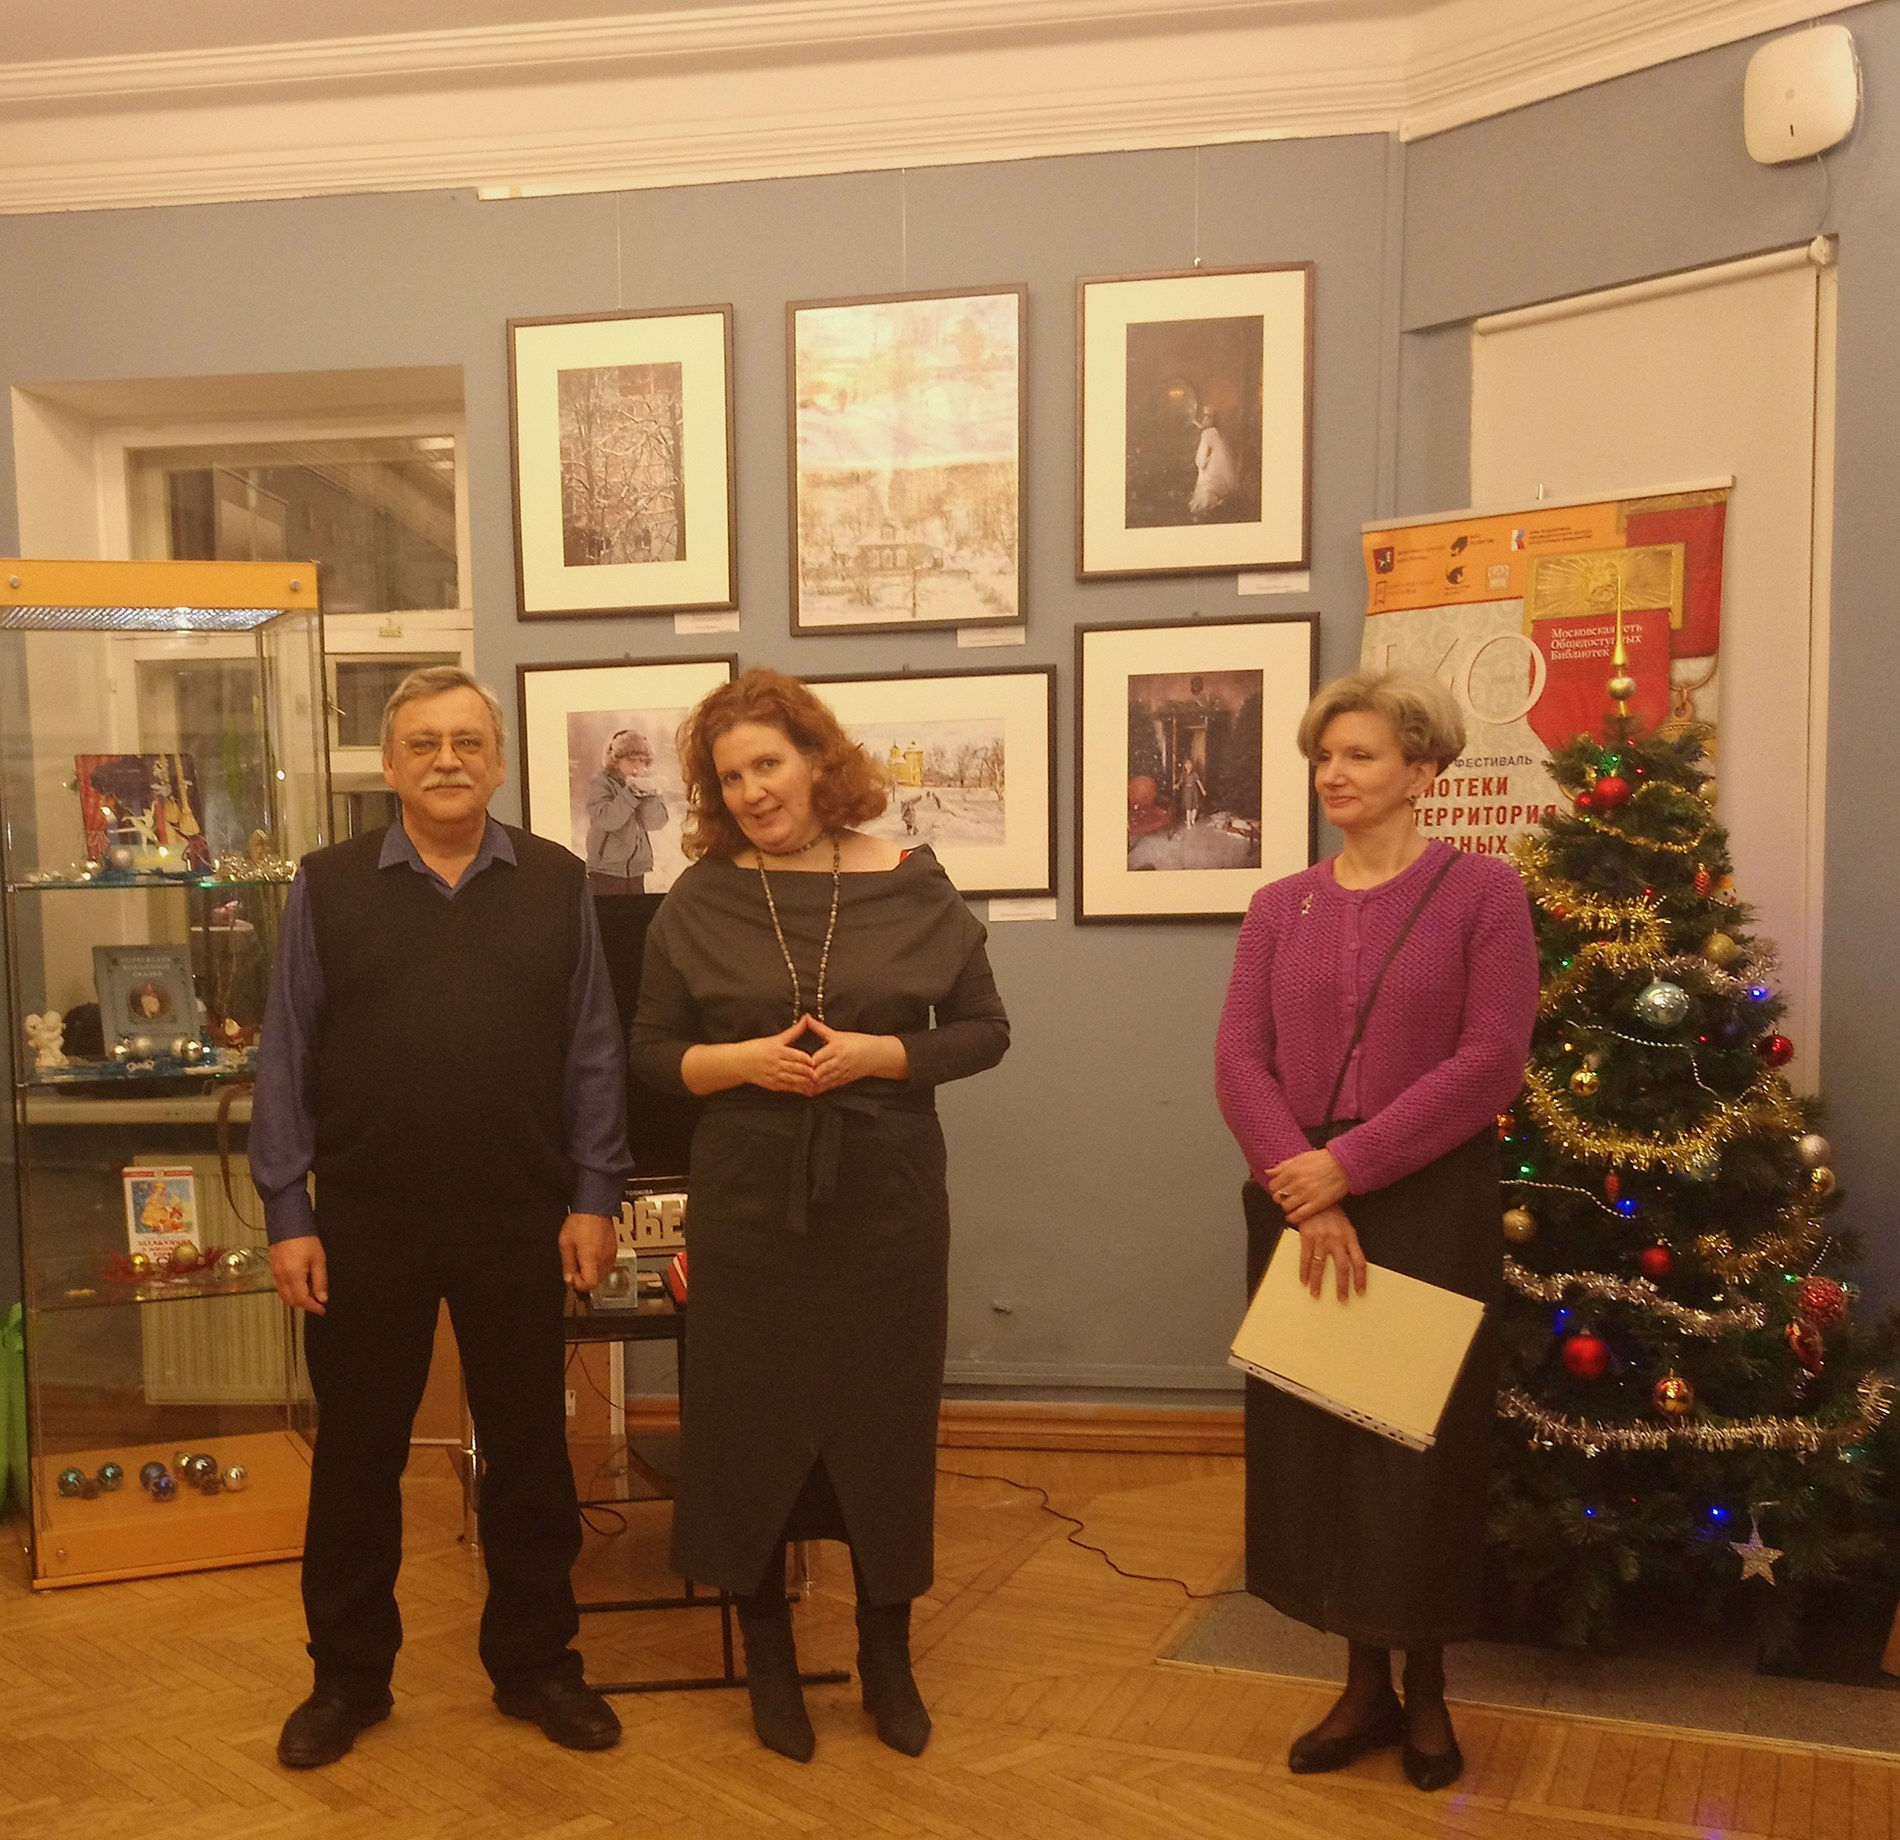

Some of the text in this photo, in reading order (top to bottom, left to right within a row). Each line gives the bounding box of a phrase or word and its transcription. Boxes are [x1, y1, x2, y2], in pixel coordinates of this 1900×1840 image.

[1622, 624, 1643, 633] еть
[1551, 636, 1642, 650] Общедоступых
[1551, 649, 1610, 660] Библиотек
[1454, 755, 1533, 768] ФЕСТИВАЛЬ
[1424, 777, 1508, 798] ИОТЕКИ
